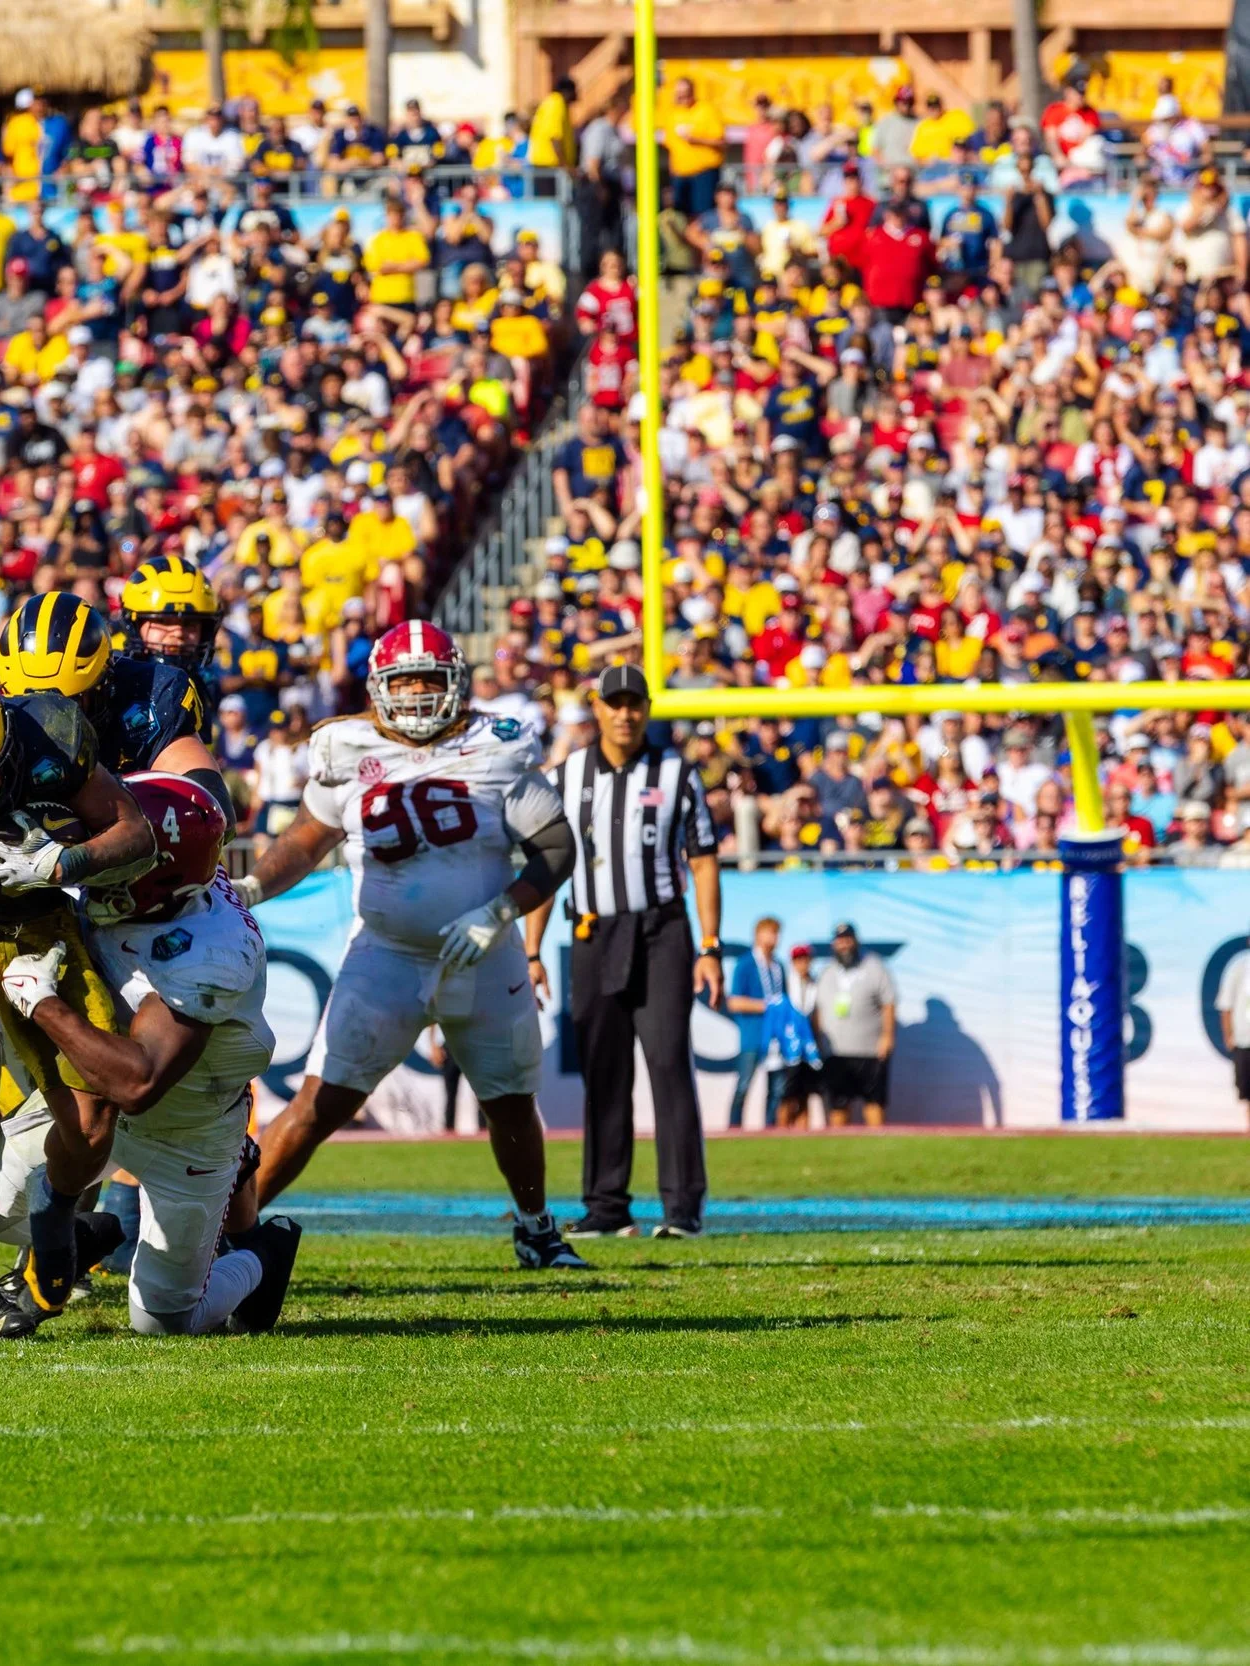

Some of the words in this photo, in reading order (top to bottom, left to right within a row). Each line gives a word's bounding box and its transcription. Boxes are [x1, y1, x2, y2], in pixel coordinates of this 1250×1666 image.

[161, 805, 180, 843] 4
[361, 778, 478, 864] 96
[642, 823, 656, 846] C
